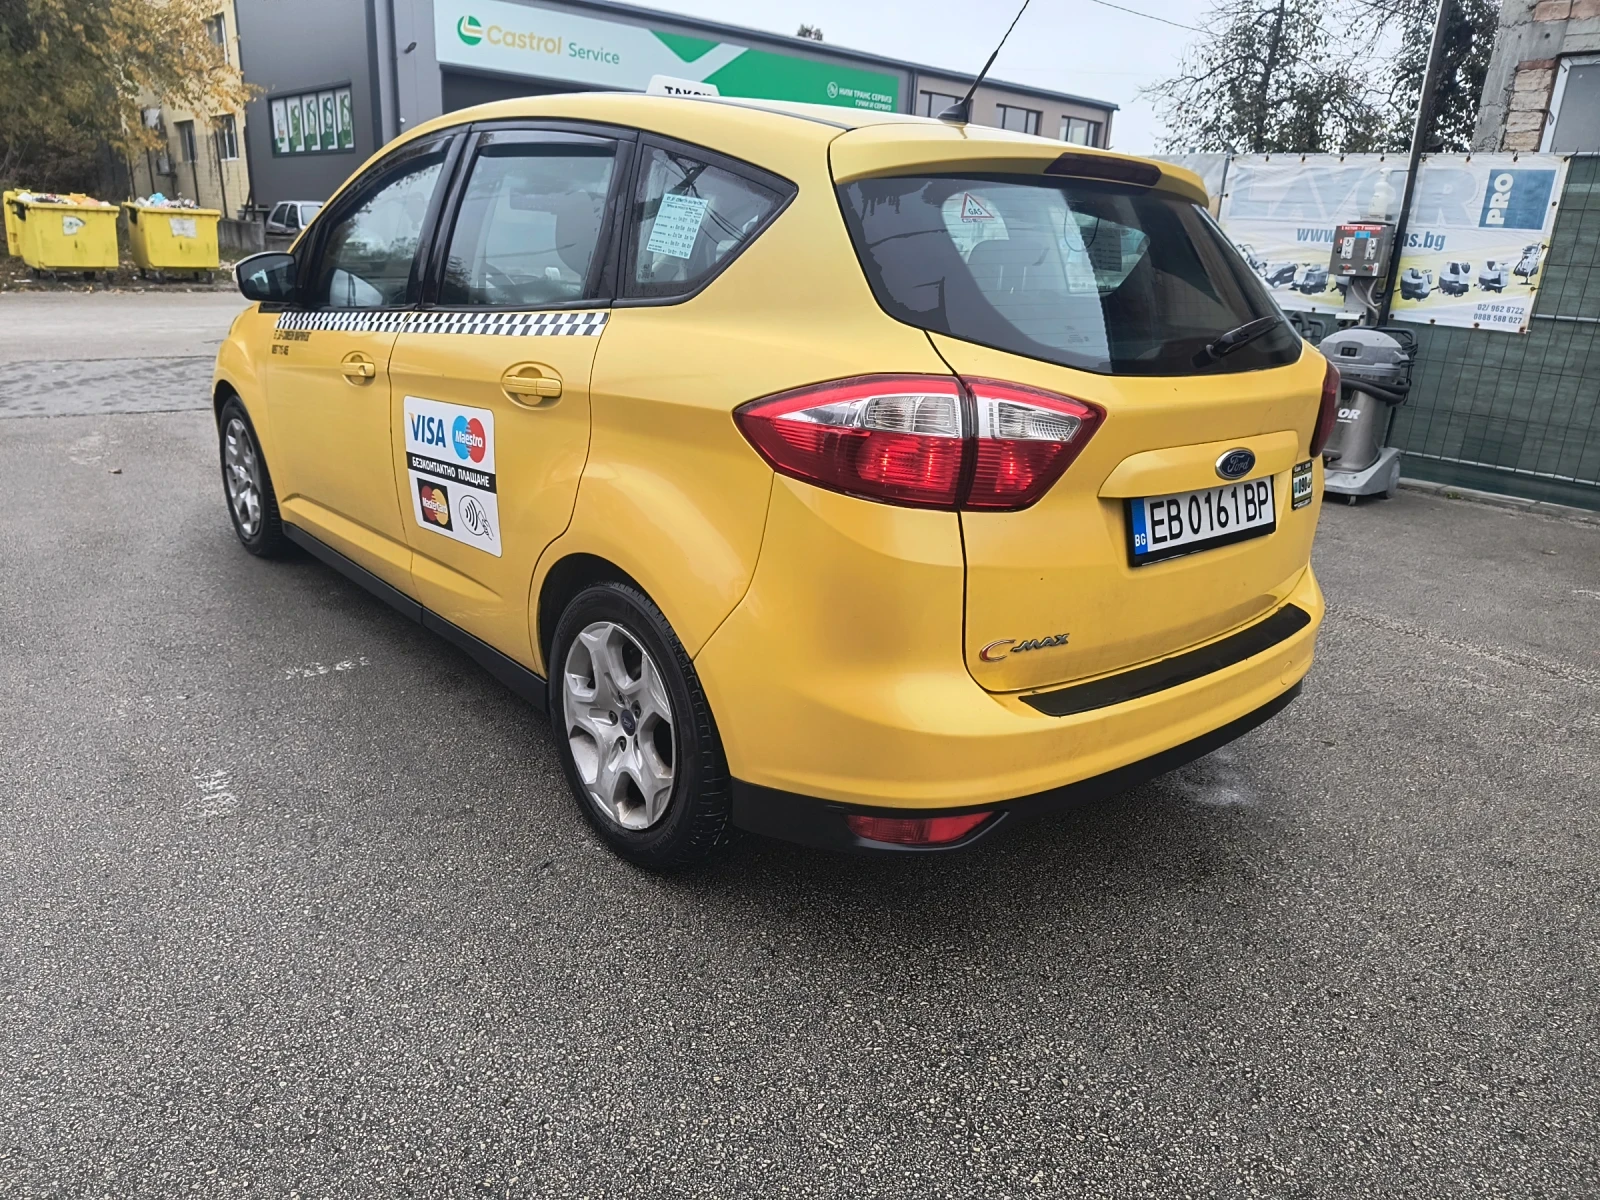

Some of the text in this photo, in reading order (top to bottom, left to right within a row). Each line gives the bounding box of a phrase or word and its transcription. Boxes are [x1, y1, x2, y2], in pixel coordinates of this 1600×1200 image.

[486, 25, 620, 64] Castrol Service
[1485, 173, 1514, 225] PRO
[408, 412, 446, 448] VISA
[455, 430, 484, 448] Maestro
[412, 456, 490, 488] БЕЗКОНТАКТНО ПЛАЩАНЕ
[1227, 454, 1250, 473] Ford
[1135, 533, 1147, 547] BG
